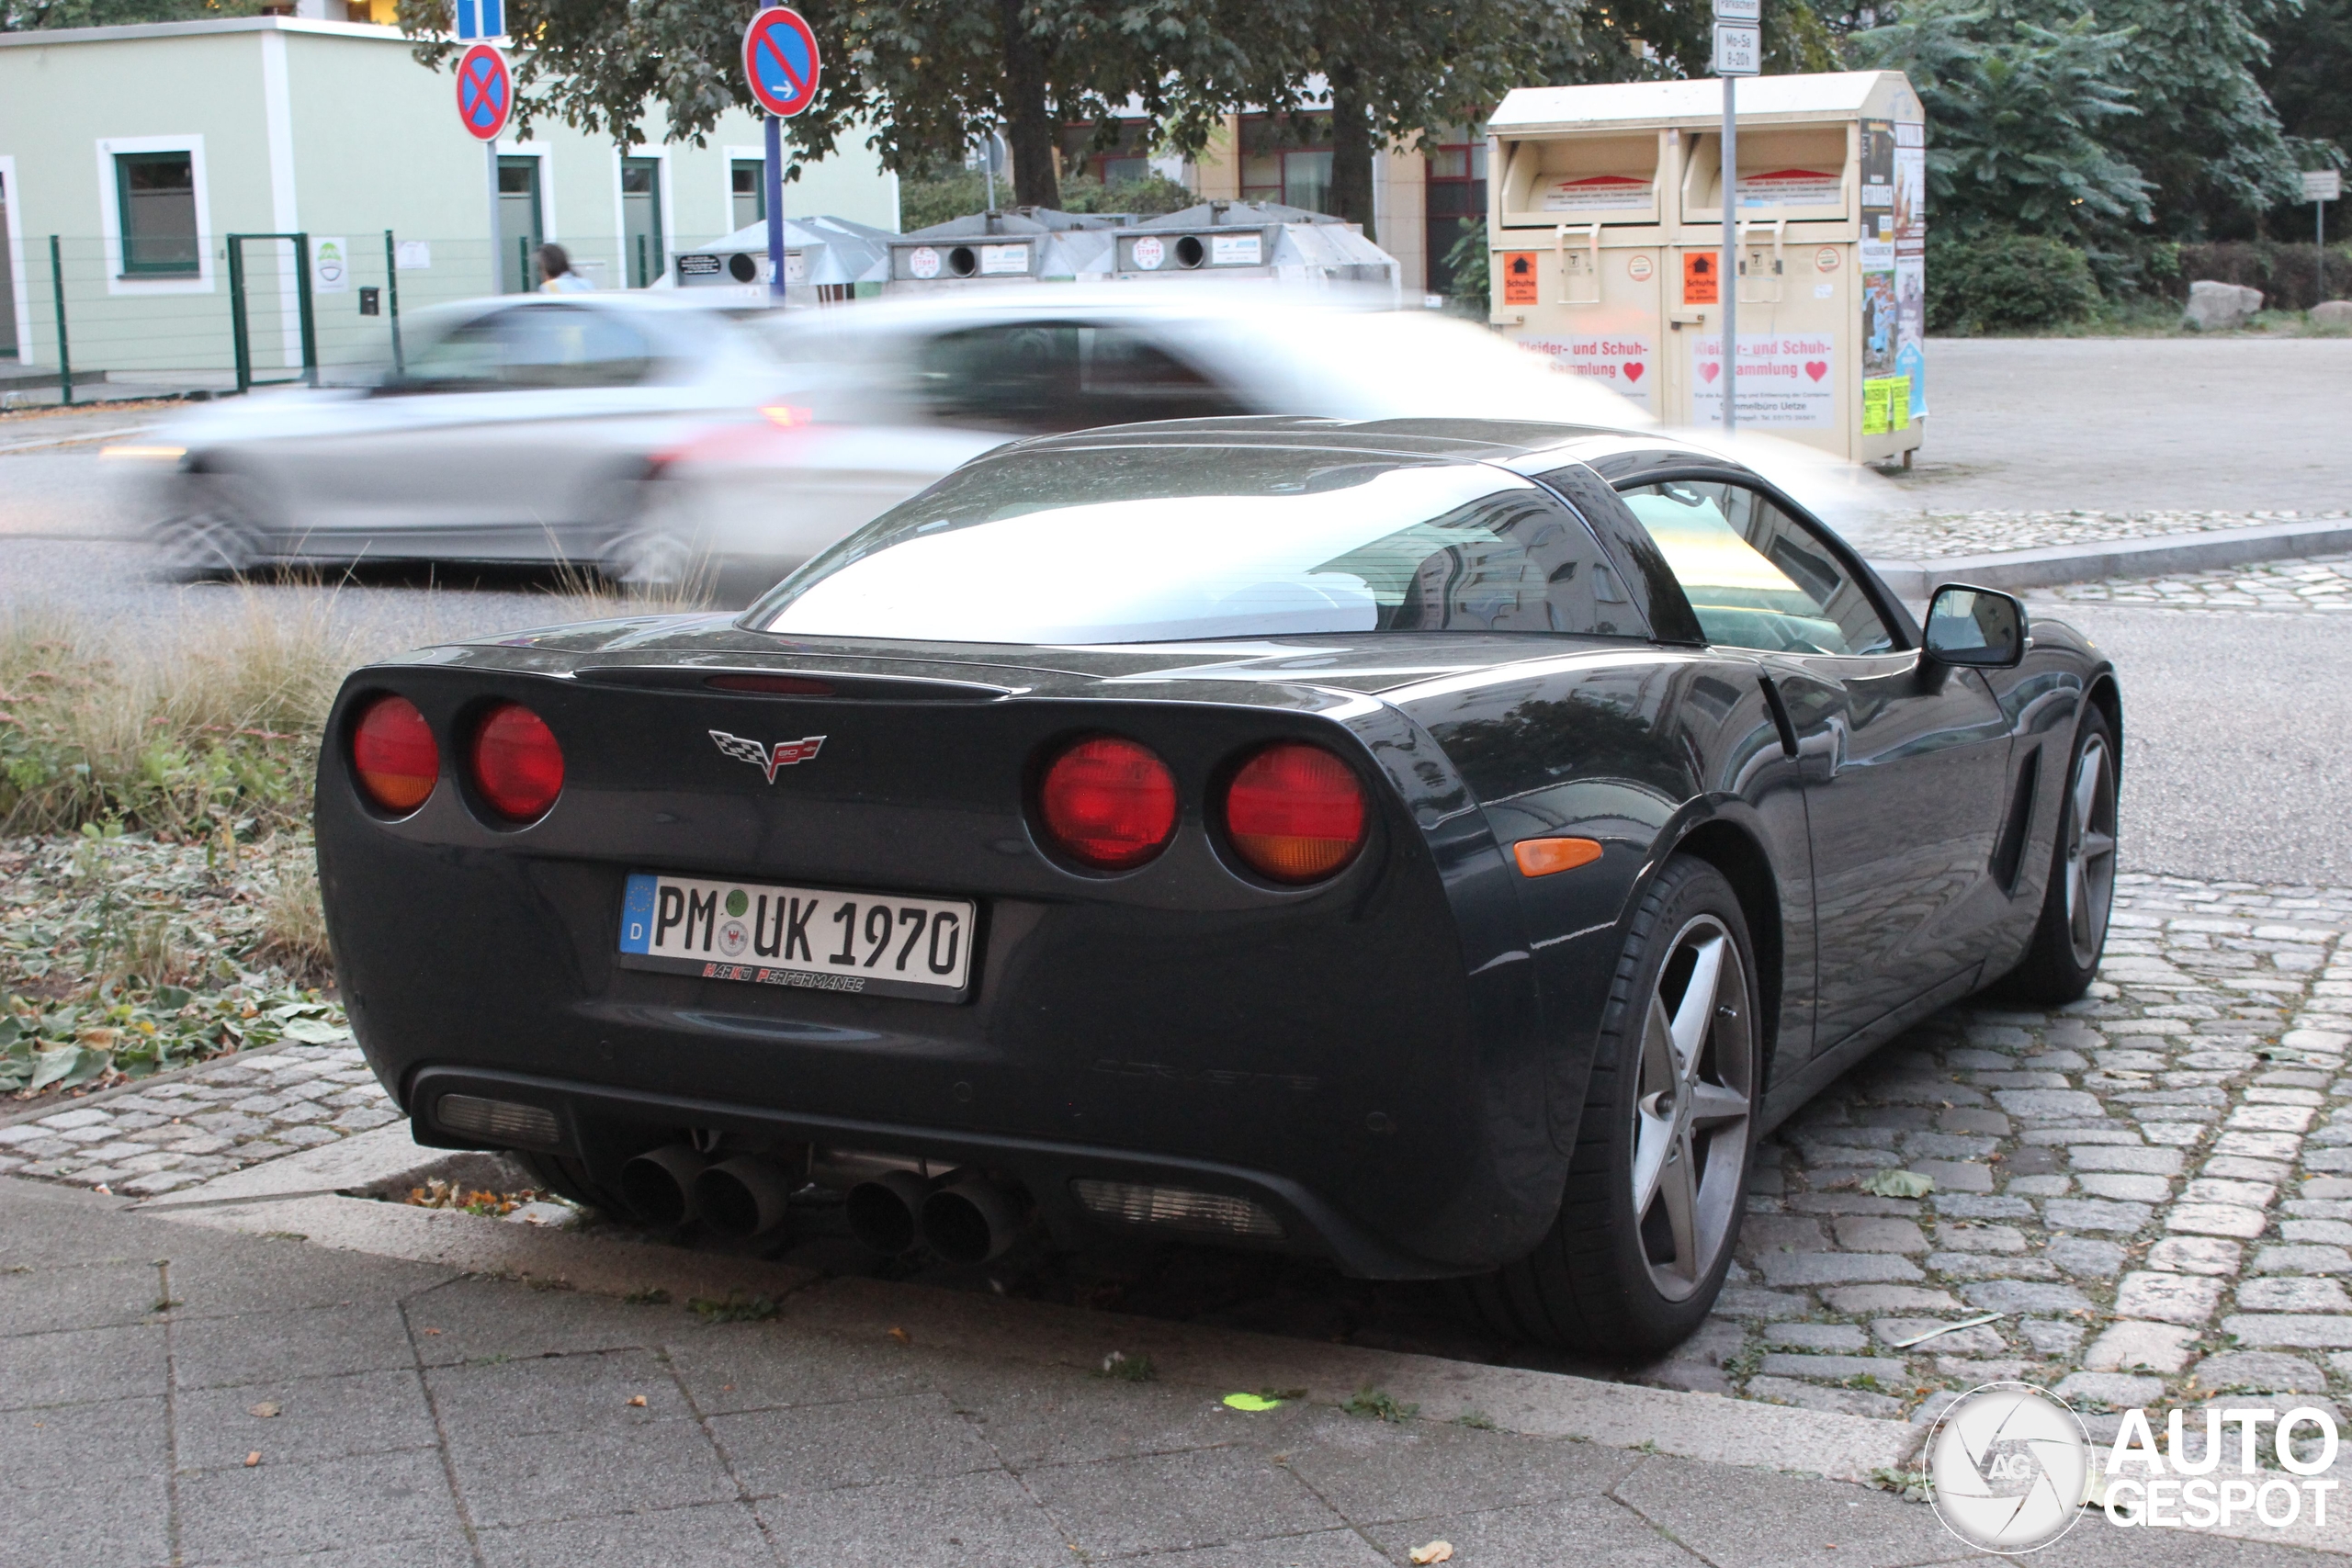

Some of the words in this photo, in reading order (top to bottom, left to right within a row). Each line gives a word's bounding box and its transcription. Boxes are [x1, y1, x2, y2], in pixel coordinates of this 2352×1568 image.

[1507, 279, 1536, 288] Schuhe
[1687, 279, 1716, 288] Schuhe
[1573, 342, 1597, 355] und
[1602, 341, 1648, 355] Schuh-
[1695, 341, 1747, 355] Kleir-
[1753, 341, 1778, 355] und
[1782, 340, 1832, 355] Schuh-
[1549, 362, 1616, 378] Sammlung
[1735, 362, 1798, 378] ammlung
[1781, 402, 1807, 411] Uetze
[630, 923, 642, 940] D
[655, 886, 718, 952] PM
[753, 894, 819, 962] UK
[829, 902, 960, 975] 1970
[755, 968, 865, 992] PERFORMANCE
